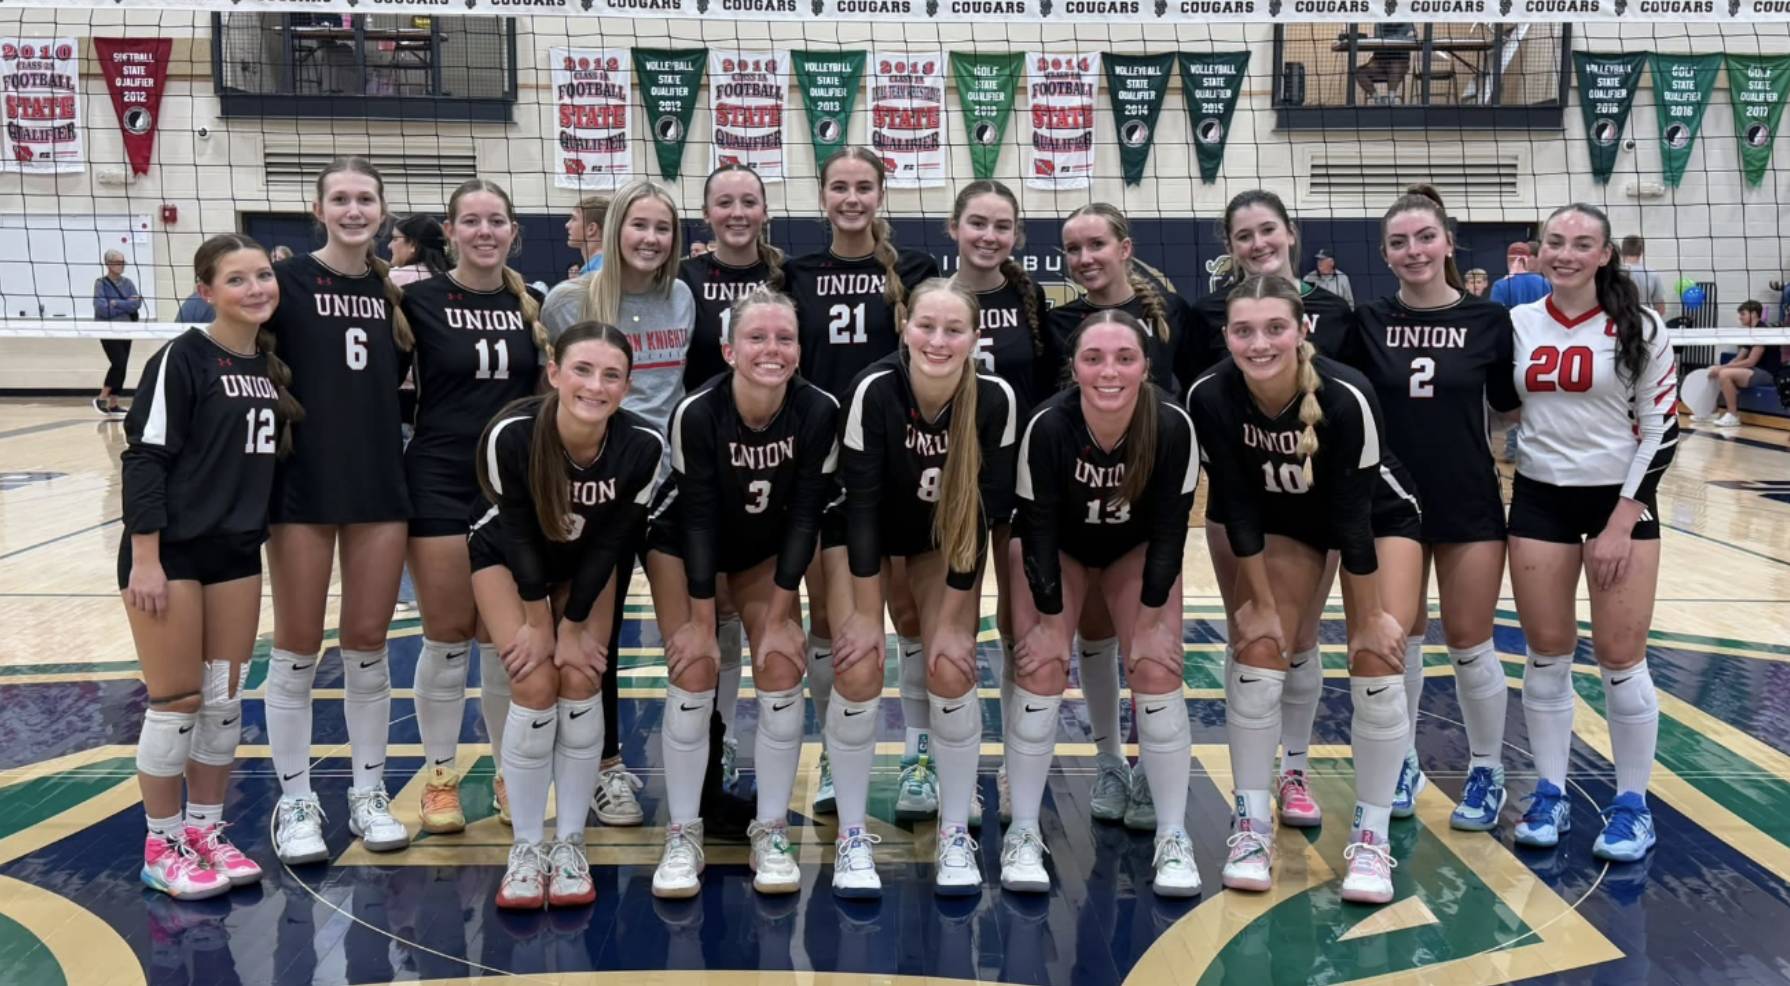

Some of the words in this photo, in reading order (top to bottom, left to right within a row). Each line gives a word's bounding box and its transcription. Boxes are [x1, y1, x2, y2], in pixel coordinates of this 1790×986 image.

[607, 0, 682, 9] COUGARS
[722, 0, 797, 12] COUGARS
[837, 1, 911, 13] COUGARS
[952, 1, 1025, 13] COUGARS
[1066, 1, 1139, 13] COUGARS
[1180, 1, 1254, 13] COUGARS
[1295, 1, 1369, 13] COUGARS
[1410, 1, 1484, 13] COUGARS
[1525, 1, 1600, 13] COUGARS
[1640, 1, 1714, 13] COUGARS
[2, 43, 73, 61] 2010
[113, 52, 155, 63] SOFTBALL
[123, 65, 146, 75] STATE
[645, 61, 694, 71] VOLLEYBALL
[804, 62, 852, 72] VOLLEYBALL
[974, 66, 1000, 76] GOLF
[1115, 65, 1162, 76] VOLLEYBALL
[1190, 64, 1237, 75] VOLLEYBALL
[1586, 64, 1633, 74] VOLLEYBALL
[1672, 64, 1697, 77] GOLF
[1747, 65, 1772, 78] GOLF
[3, 72, 76, 92] FOOTBALL
[115, 78, 154, 88] QUALIFIER
[658, 75, 681, 84] STATE
[817, 77, 840, 85] STATE
[975, 80, 998, 90] STATE
[1126, 79, 1149, 89] STATE
[1202, 78, 1225, 87] STATE
[1597, 77, 1620, 87] STATE
[1672, 80, 1695, 90] STATE
[1748, 80, 1771, 91] STATE
[123, 91, 147, 103] 2012
[558, 82, 626, 101] FOOTBALL
[651, 86, 689, 96] QUALIFIER
[715, 82, 784, 101] FOOTBALL
[810, 87, 847, 97] QUALIFIER
[968, 91, 1005, 101] QUALIFIER
[1032, 81, 1094, 99] FOOTBALL
[1118, 90, 1156, 100] QUALIFIER
[1195, 89, 1232, 99] QUALIFIER
[1588, 89, 1627, 99] QUALIFIER
[1664, 91, 1702, 101] QUALIFIER
[1740, 92, 1778, 102] QUALIFIER
[6, 94, 76, 121] STATE
[559, 103, 626, 129] STATE
[715, 102, 783, 128] STATE
[817, 102, 840, 112] 2013
[1125, 105, 1149, 116] 2014
[1595, 103, 1619, 114] 2016
[1670, 106, 1693, 117] 2016
[1746, 106, 1769, 117] 2017
[872, 105, 940, 129] STATE
[1031, 104, 1094, 130] STATE
[8, 121, 77, 143] QUALIFIER
[715, 129, 783, 152] QUALIFIER
[559, 130, 627, 153] QUALIFIER
[872, 130, 940, 153] QUALIFIER
[1032, 130, 1093, 153] QUALIFIER
[703, 280, 765, 301] UNIO
[816, 273, 887, 296] UNION
[314, 293, 386, 320] UNION
[444, 307, 524, 331] UNION
[719, 307, 732, 345] 1
[828, 303, 868, 345] 21
[979, 308, 1018, 329] ION
[1386, 326, 1468, 349] UNION
[345, 327, 369, 371] 6
[474, 338, 510, 380] 11
[1408, 357, 1435, 398] 2
[1525, 345, 1594, 392] 20
[220, 374, 280, 400] UNION
[245, 408, 276, 454] 12
[905, 423, 949, 457] UNIO
[729, 436, 795, 470] UNION
[1074, 457, 1126, 488] UNIO
[1262, 460, 1310, 494] 10
[573, 477, 616, 506] ION
[917, 467, 943, 503] 8
[745, 480, 772, 514] 3
[1084, 498, 1132, 524] 13
